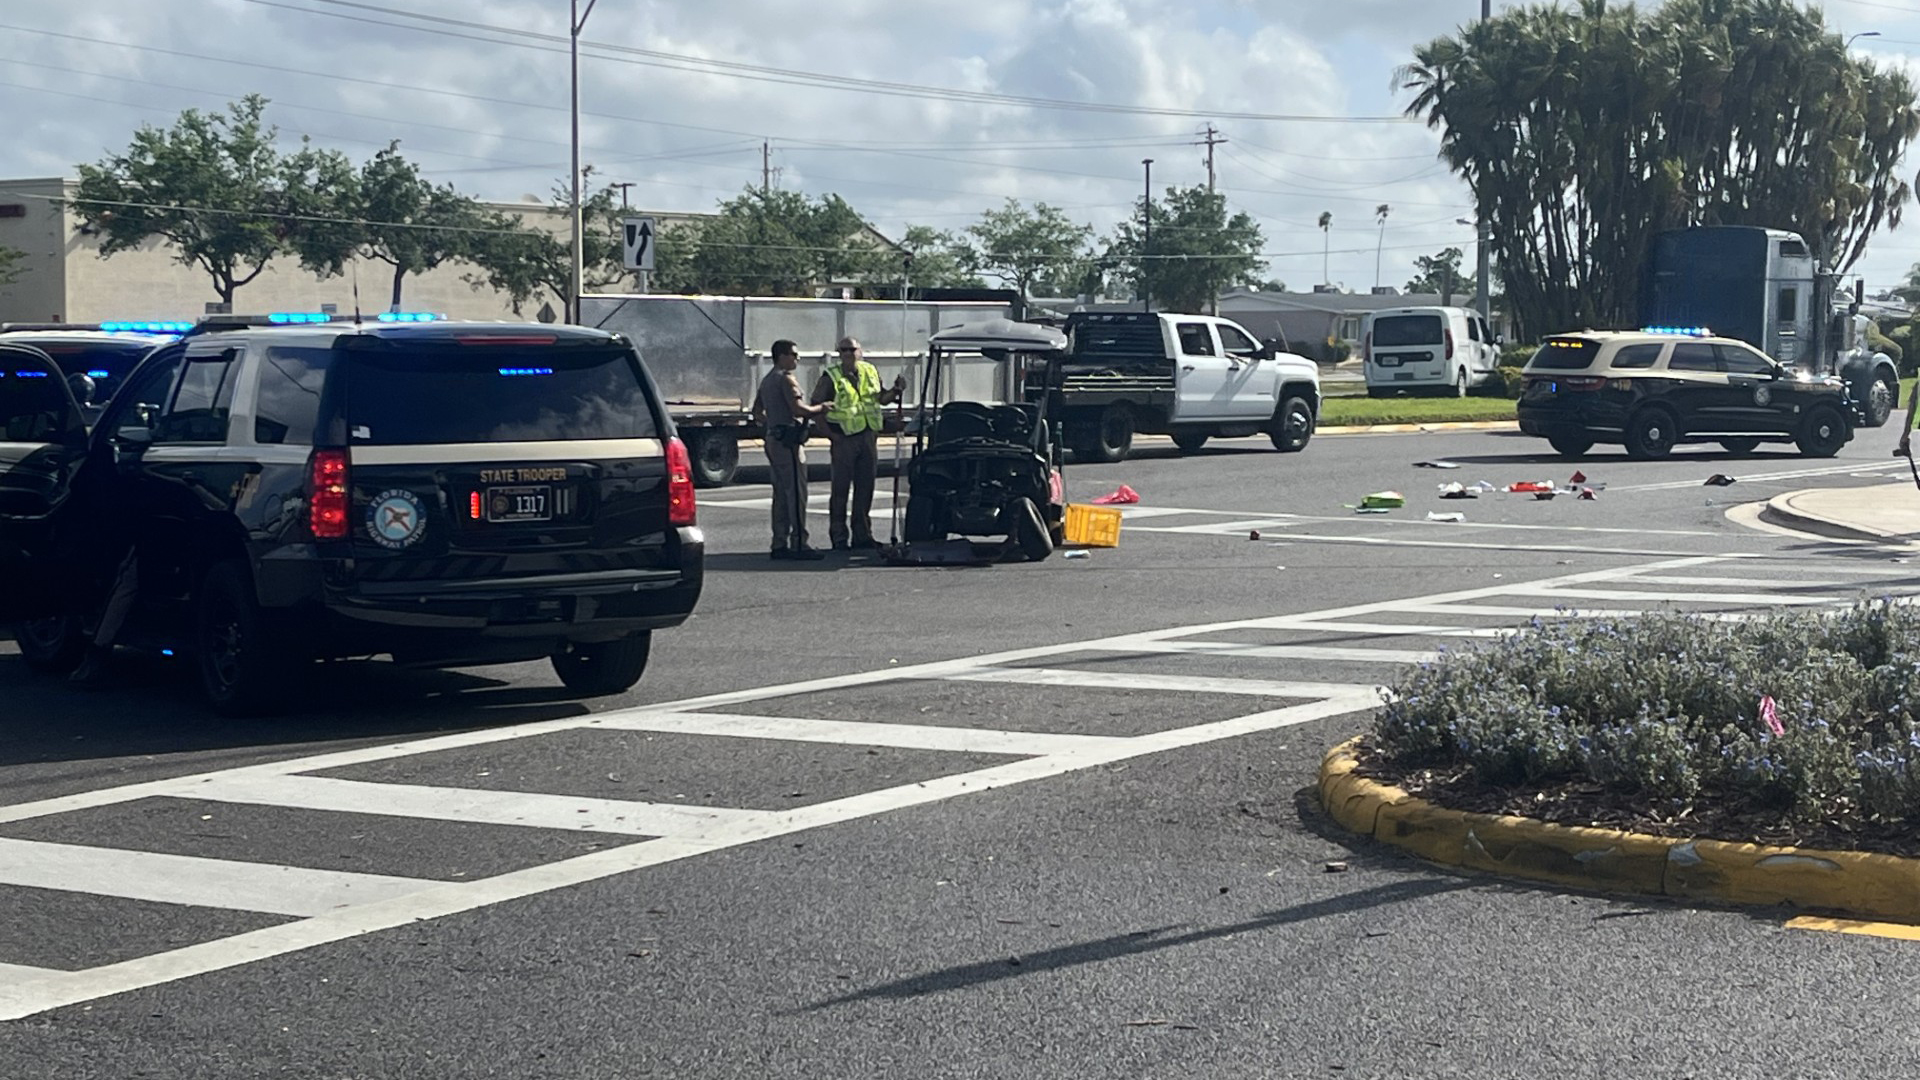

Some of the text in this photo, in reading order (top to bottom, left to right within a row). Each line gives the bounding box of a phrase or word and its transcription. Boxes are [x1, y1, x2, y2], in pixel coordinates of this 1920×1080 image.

[480, 467, 567, 483] STATE TROOPER
[370, 489, 418, 508] FLORIDA
[516, 495, 545, 513] 1317
[366, 517, 427, 548] HIGHWAY PATROL
